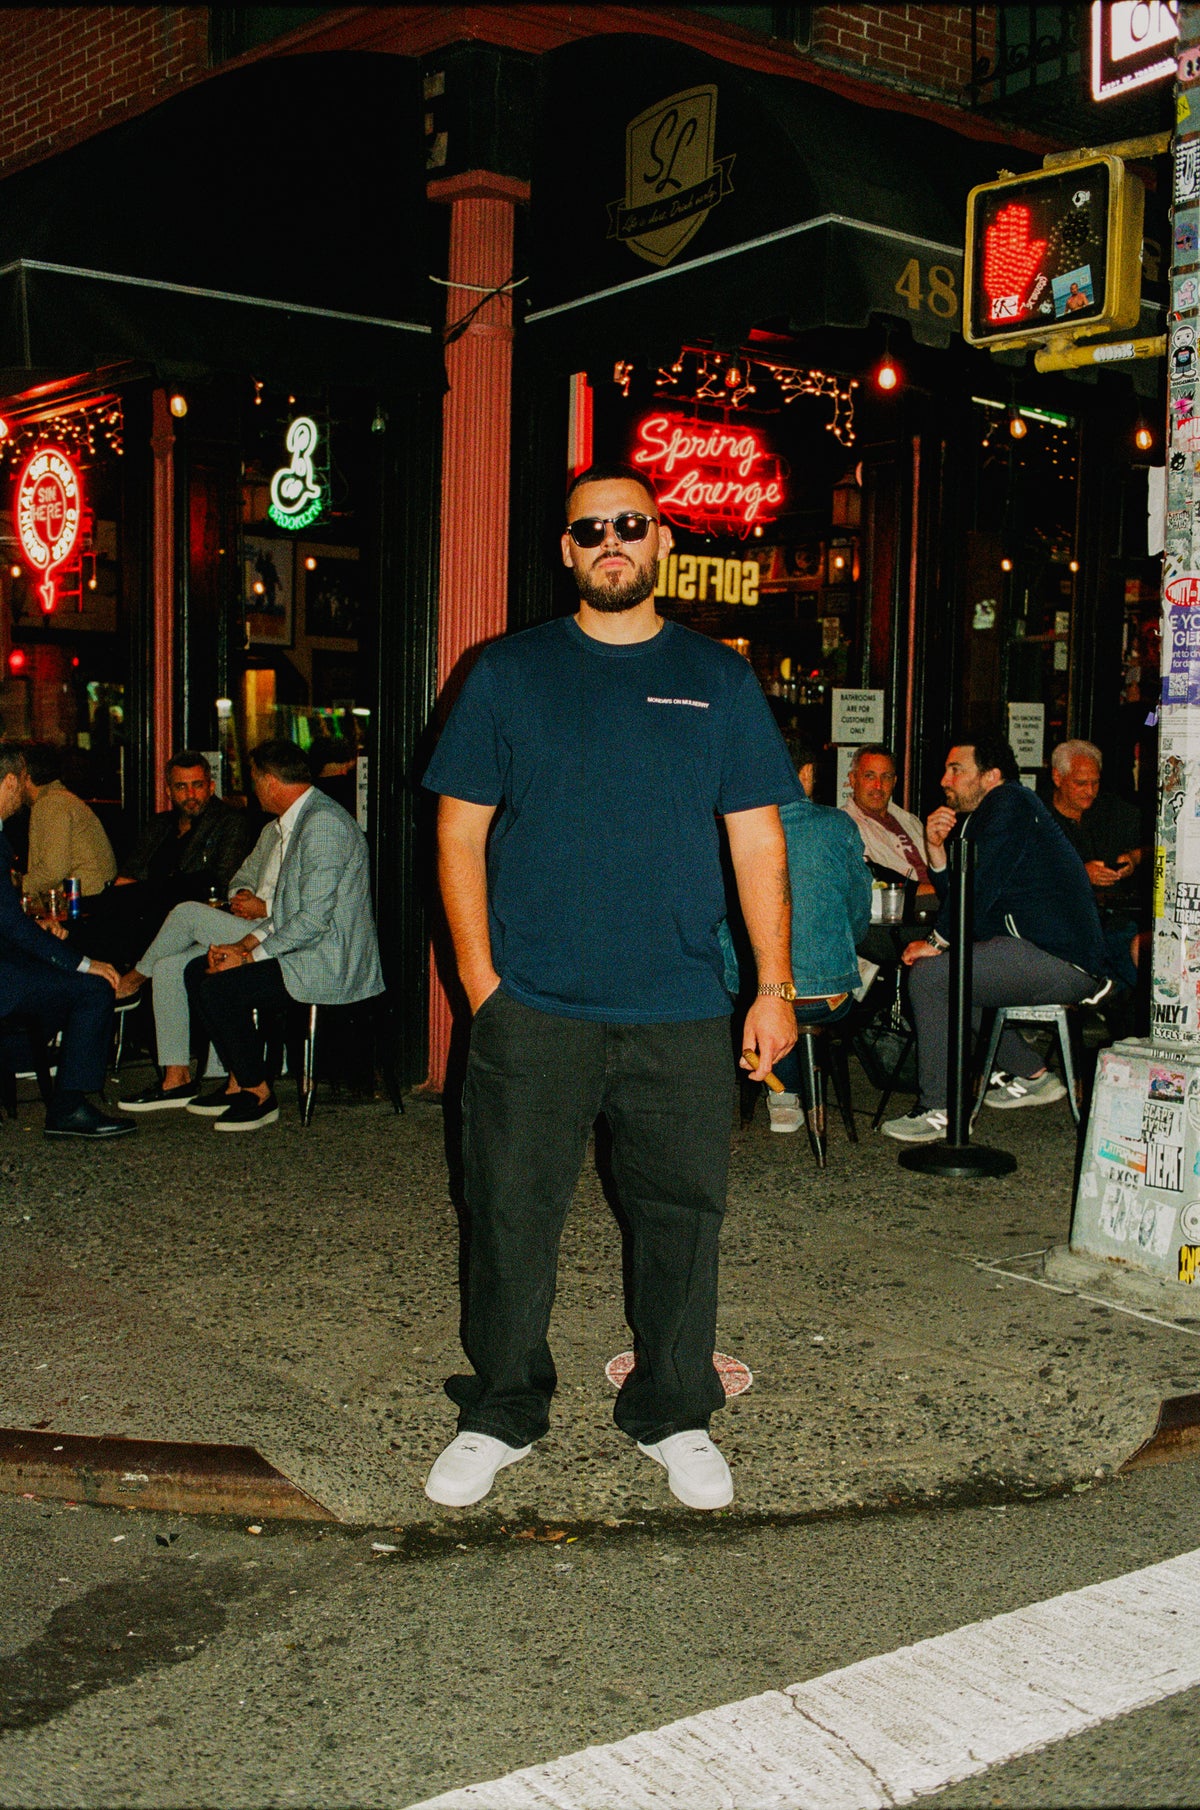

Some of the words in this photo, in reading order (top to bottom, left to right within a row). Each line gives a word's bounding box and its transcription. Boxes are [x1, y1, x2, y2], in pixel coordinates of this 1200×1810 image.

[643, 108, 697, 193] SL
[895, 258, 958, 318] 48
[635, 418, 761, 477] Spring
[658, 470, 781, 521] Lounge
[841, 694, 876, 702] BATHROOMS
[847, 705, 858, 713] ARE
[859, 705, 870, 713] FOR
[841, 716, 875, 724] CUSTOMERS
[850, 727, 866, 735] ONLY
